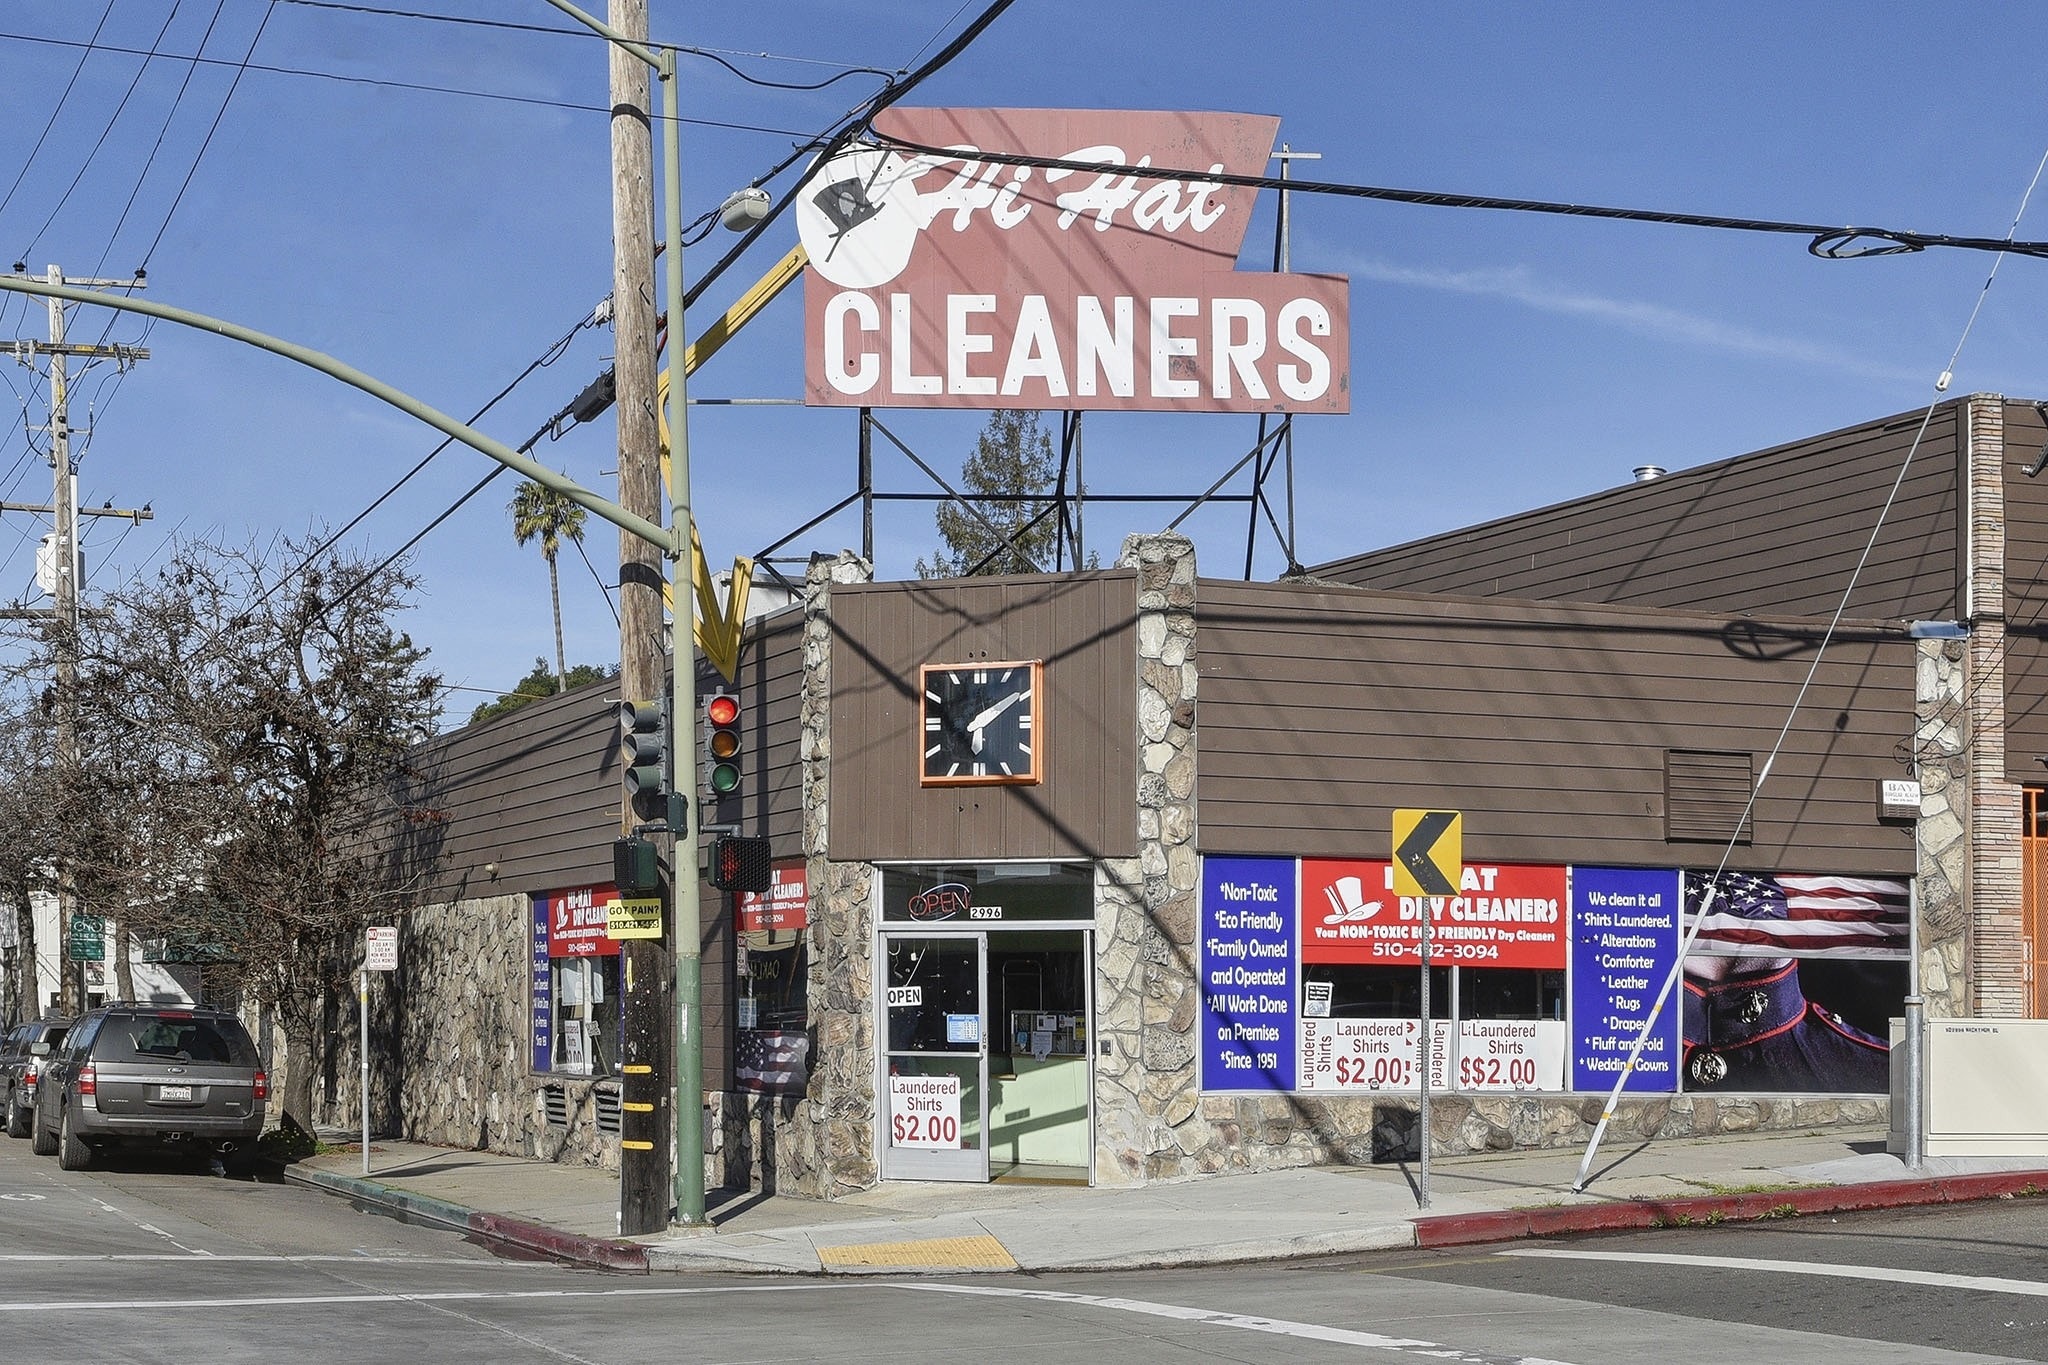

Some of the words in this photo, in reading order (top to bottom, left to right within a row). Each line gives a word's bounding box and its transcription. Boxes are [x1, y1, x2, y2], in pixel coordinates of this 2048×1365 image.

[914, 146, 1033, 232] Hi
[1044, 145, 1227, 233] Hat
[823, 290, 1333, 401] CLEANERS
[1888, 783, 1914, 792] BAY
[908, 889, 971, 916] OPEN
[1588, 891, 1607, 906] We
[1608, 892, 1636, 907] clean
[1638, 894, 1646, 907] it
[1648, 893, 1661, 907] all
[609, 906, 629, 915] GOT
[631, 905, 660, 915] PAIN?
[971, 908, 1001, 918] 2996
[1449, 897, 1559, 924] CLEANERS
[1240, 911, 1283, 933] Friendly
[1584, 912, 1612, 926] Shirts
[1614, 913, 1673, 928] Laundered.
[1315, 927, 1338, 938] Your
[1340, 925, 1409, 939] NON-TOXIC
[1438, 926, 1496, 940] FRIENDLY
[1498, 929, 1515, 943] Dry
[1516, 929, 1556, 942] Cleaners
[1600, 933, 1656, 948] Alterations
[1249, 938, 1288, 957] Owned
[1602, 953, 1655, 969] Comforter
[1211, 966, 1233, 985] and
[1235, 966, 1286, 988] Operated
[1608, 975, 1649, 989] Leather
[888, 989, 920, 1004] OPEN
[1228, 994, 1257, 1013] Work
[1259, 995, 1288, 1013] Done
[1616, 995, 1641, 1011] Rugs
[1218, 1027, 1232, 1041] on
[1234, 1022, 1280, 1041] Premises
[1336, 1022, 1403, 1037] Laundered
[1472, 1023, 1536, 1038] Laundered
[1610, 1016, 1647, 1032] Drapes
[1353, 1039, 1390, 1054] Shirts
[1488, 1040, 1524, 1055] Shirts
[1592, 1036, 1616, 1050] Fluff
[1618, 1037, 1639, 1050] and
[1257, 1053, 1277, 1069] 1951
[1301, 1022, 1316, 1088] Laundered
[1317, 1035, 1332, 1073] Shirts
[1431, 1022, 1450, 1087] Laundered
[1336, 1056, 1401, 1087] $2.00
[1472, 1056, 1536, 1087] $2.00
[1586, 1057, 1633, 1073] Weddin
[1635, 1057, 1669, 1072] Gowns
[892, 1079, 957, 1095] Laundered
[907, 1097, 943, 1112] Shirts
[894, 1113, 957, 1144] $2.00
